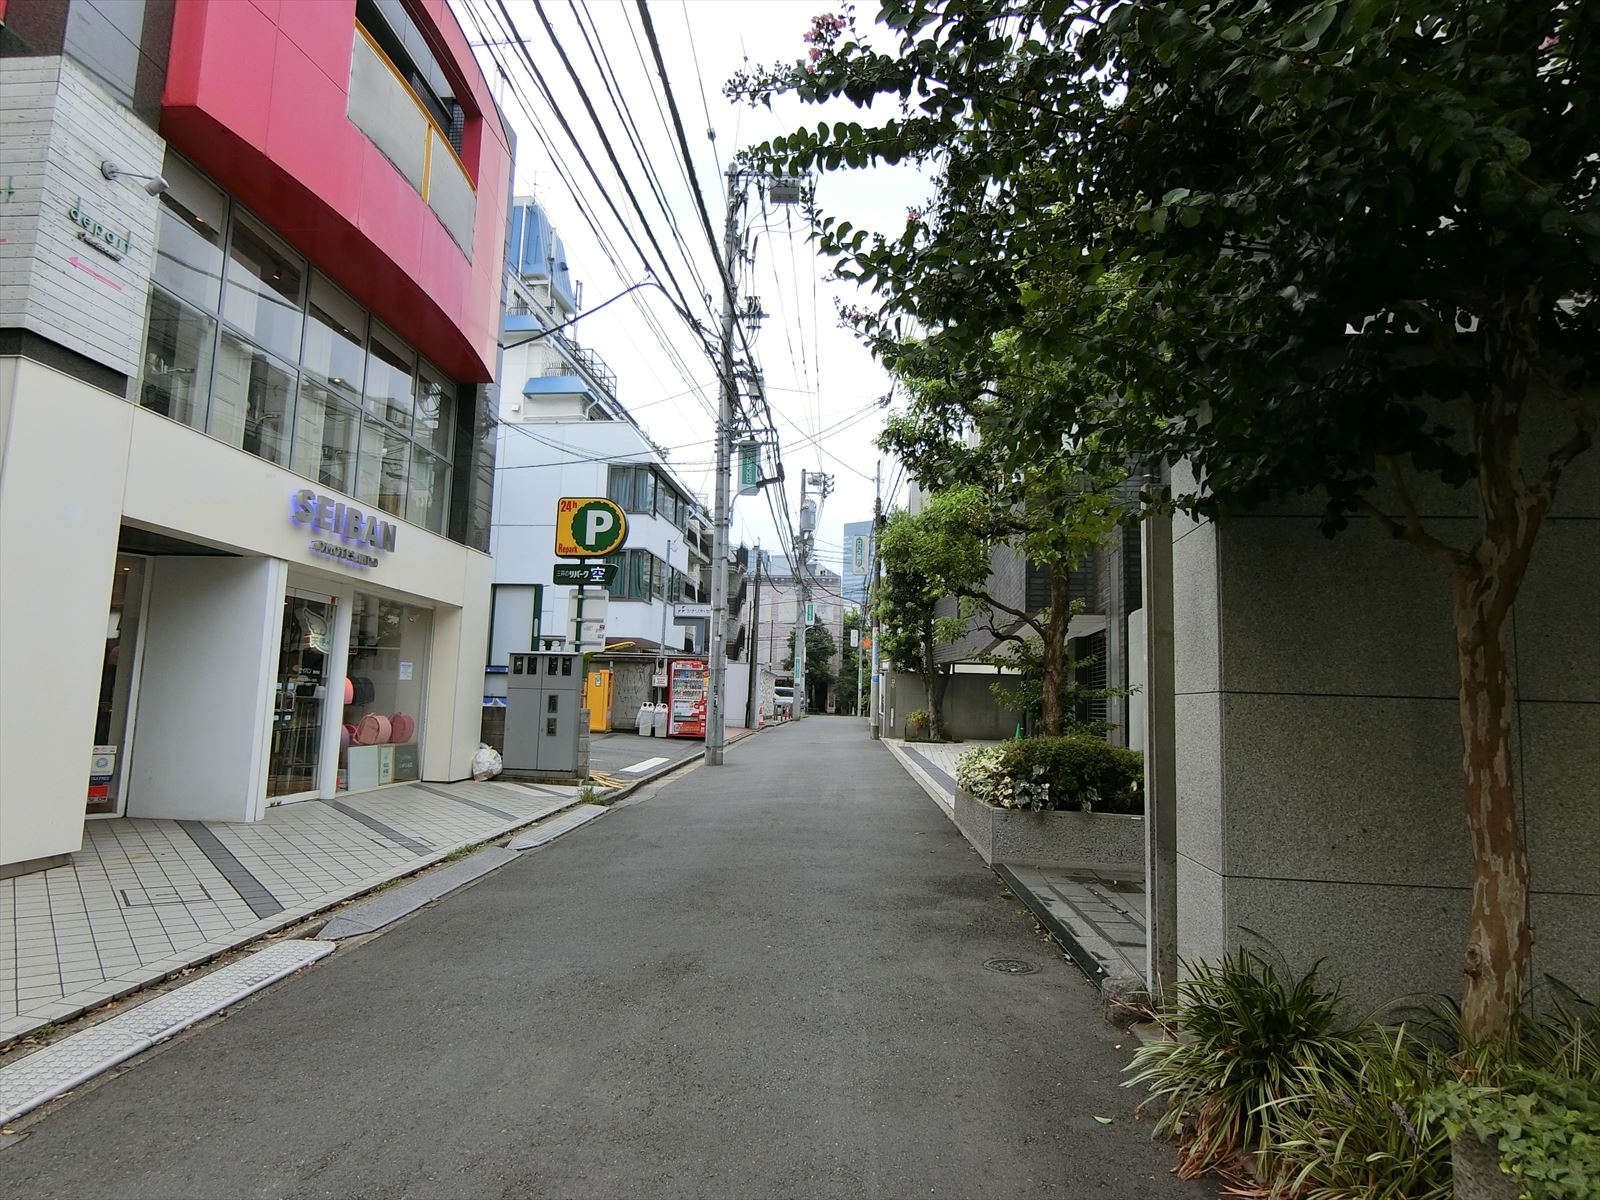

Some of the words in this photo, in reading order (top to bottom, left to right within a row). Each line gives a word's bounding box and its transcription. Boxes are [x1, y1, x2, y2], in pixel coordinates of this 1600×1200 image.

[560, 500, 578, 513] 24h
[295, 489, 397, 552] SEIBAN
[585, 509, 614, 546] P
[558, 543, 578, 554] Repark
[589, 566, 606, 582] 空
